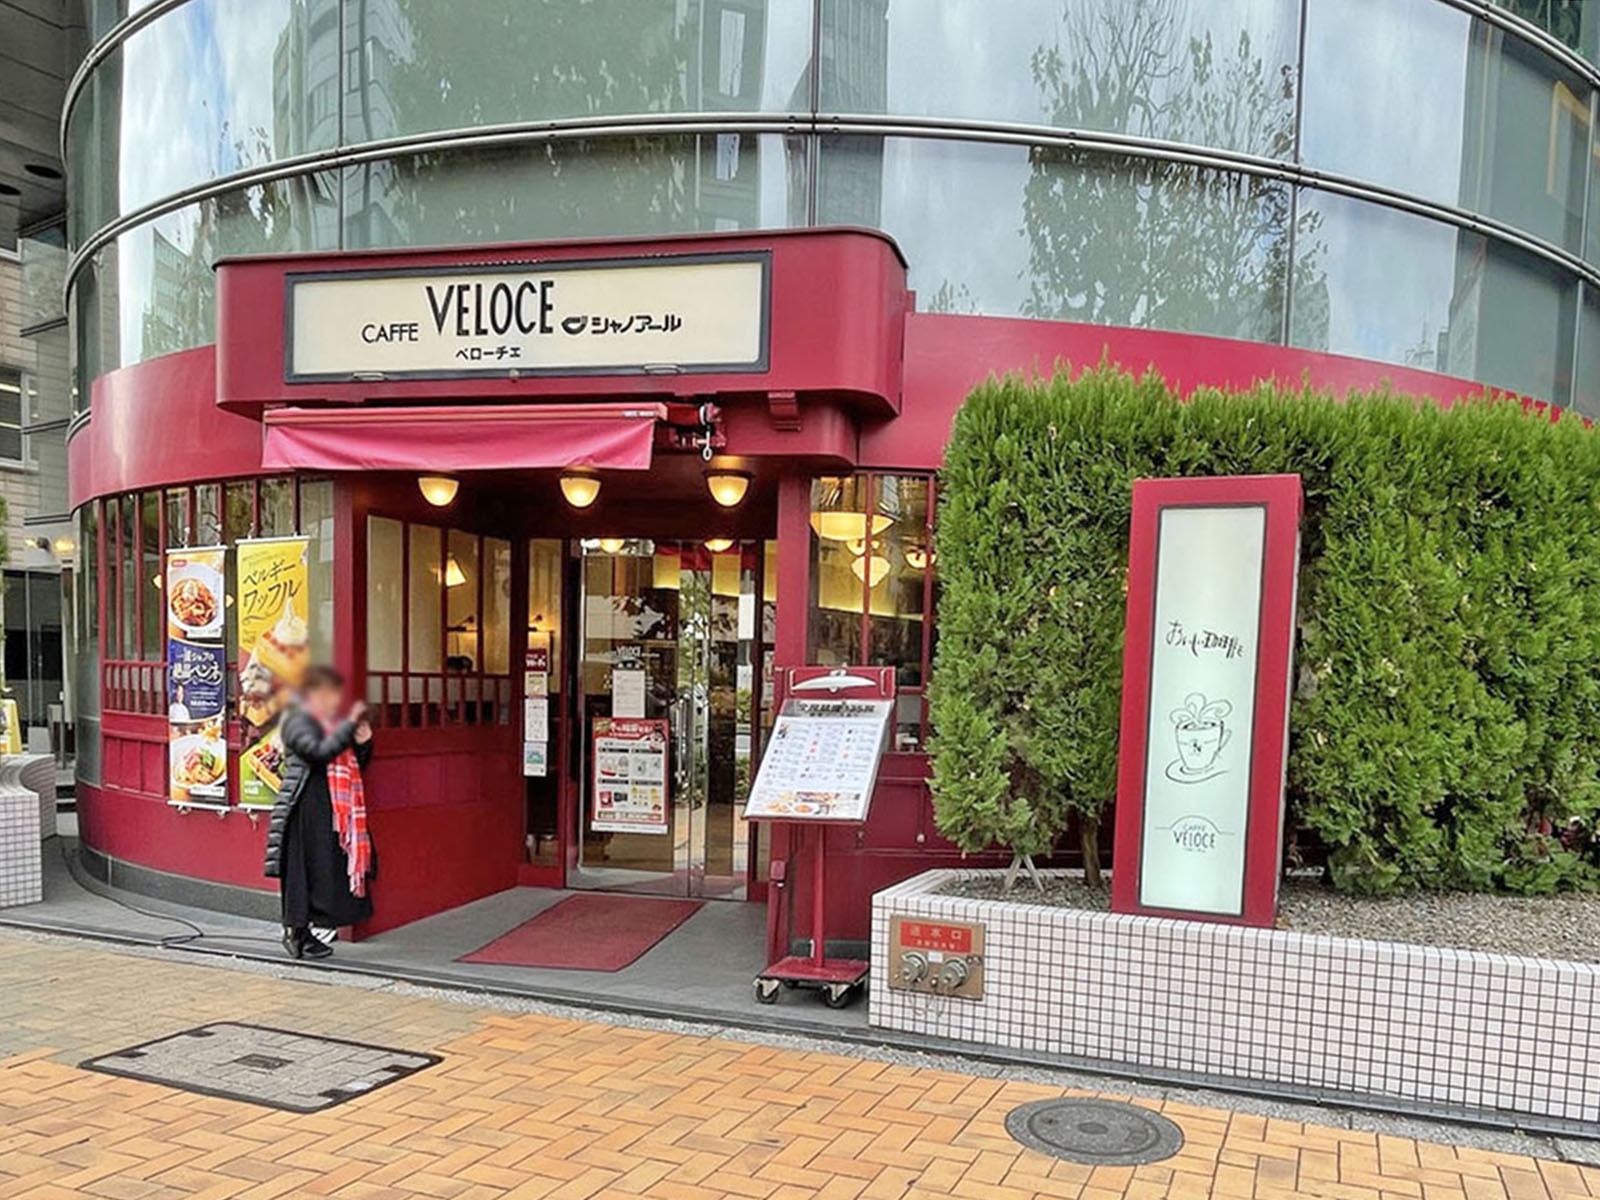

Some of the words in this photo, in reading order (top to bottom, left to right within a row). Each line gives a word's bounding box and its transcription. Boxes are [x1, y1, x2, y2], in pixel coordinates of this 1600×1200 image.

[362, 323, 419, 343] CAFFE
[426, 280, 554, 336] VELOCE
[591, 314, 682, 335] シャノアール
[243, 560, 296, 585] ベルギー
[243, 580, 303, 616] ワッフル
[1173, 831, 1216, 848] VELOCE
